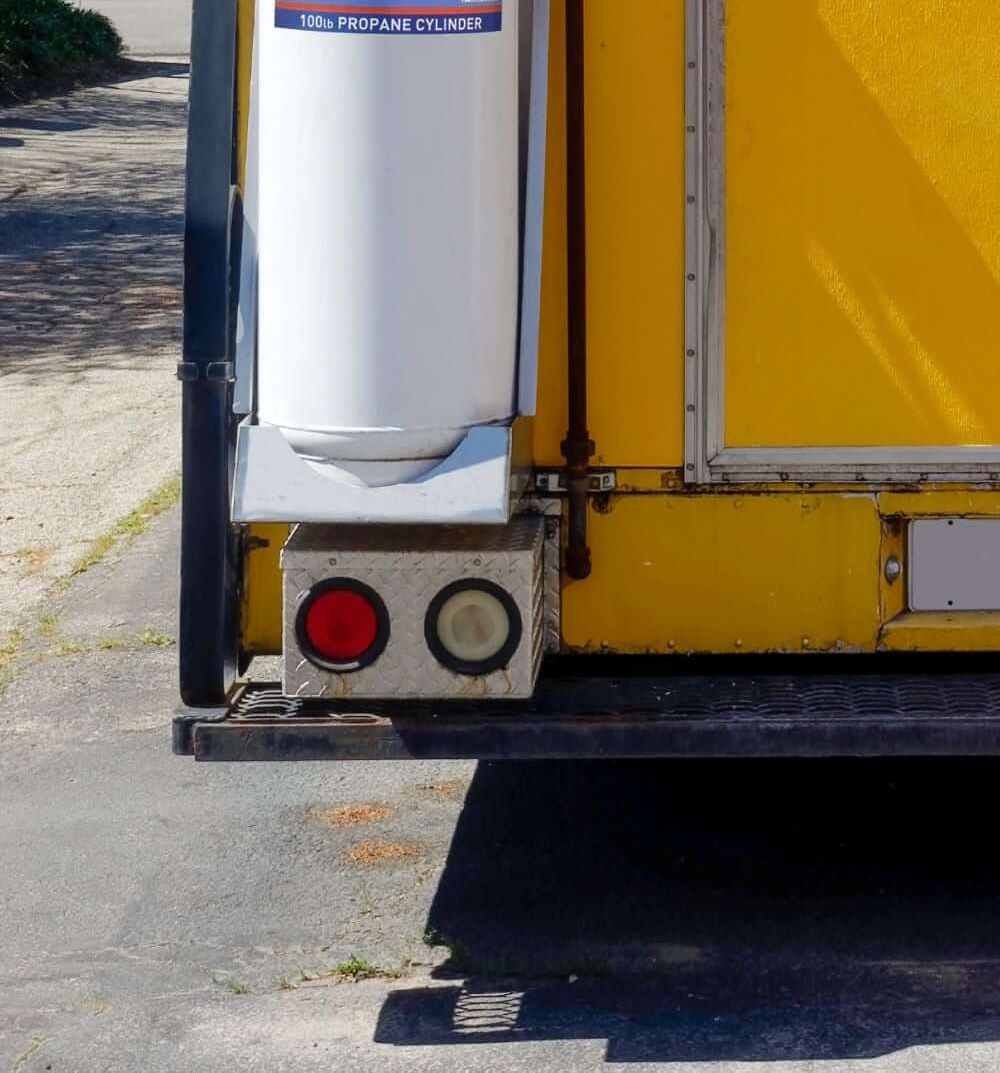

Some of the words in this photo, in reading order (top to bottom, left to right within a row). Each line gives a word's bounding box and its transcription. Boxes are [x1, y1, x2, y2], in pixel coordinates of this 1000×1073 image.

[300, 14, 333, 29] 100lb
[338, 16, 411, 31] PROPANE
[415, 16, 482, 31] CYLINDER
